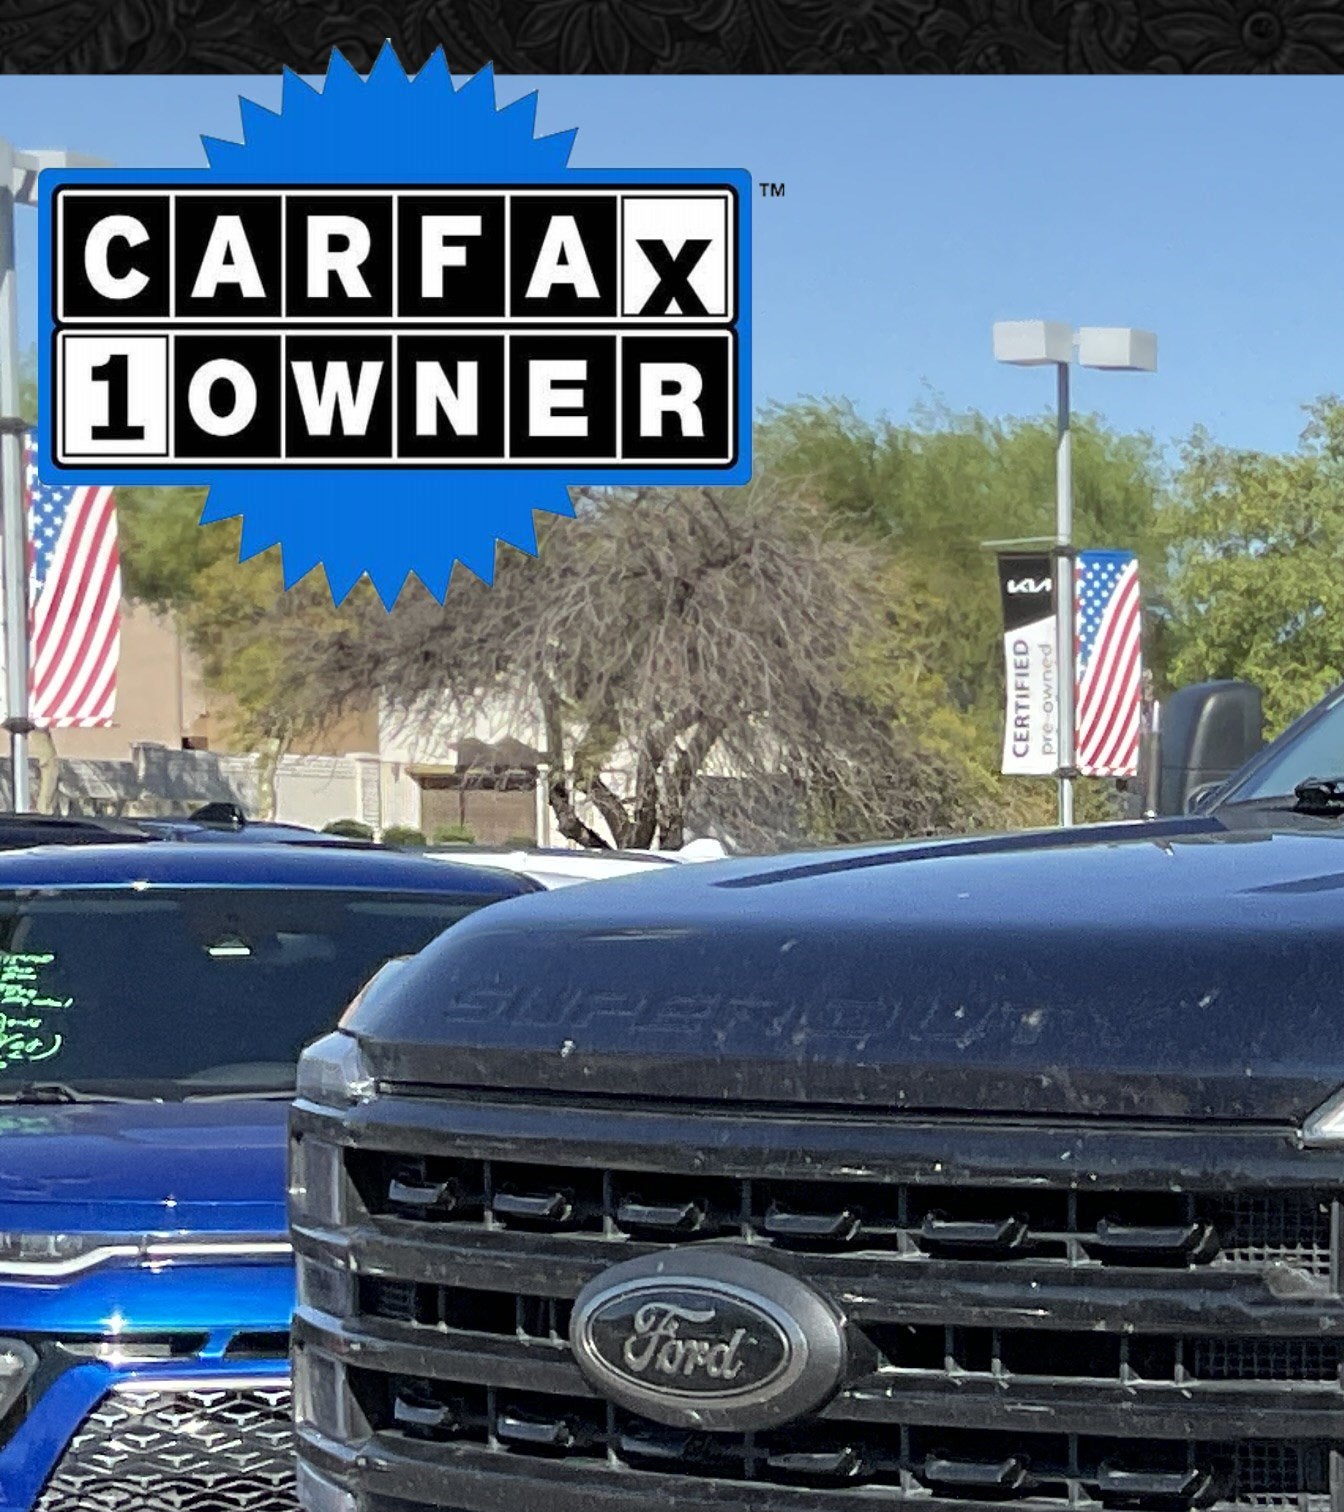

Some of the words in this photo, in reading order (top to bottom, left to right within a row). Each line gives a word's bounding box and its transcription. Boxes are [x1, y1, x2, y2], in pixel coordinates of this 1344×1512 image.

[1012, 640, 1031, 759] CERTIFIED
[1039, 643, 1056, 756] pre-owned
[623, 1302, 748, 1380] Ford
